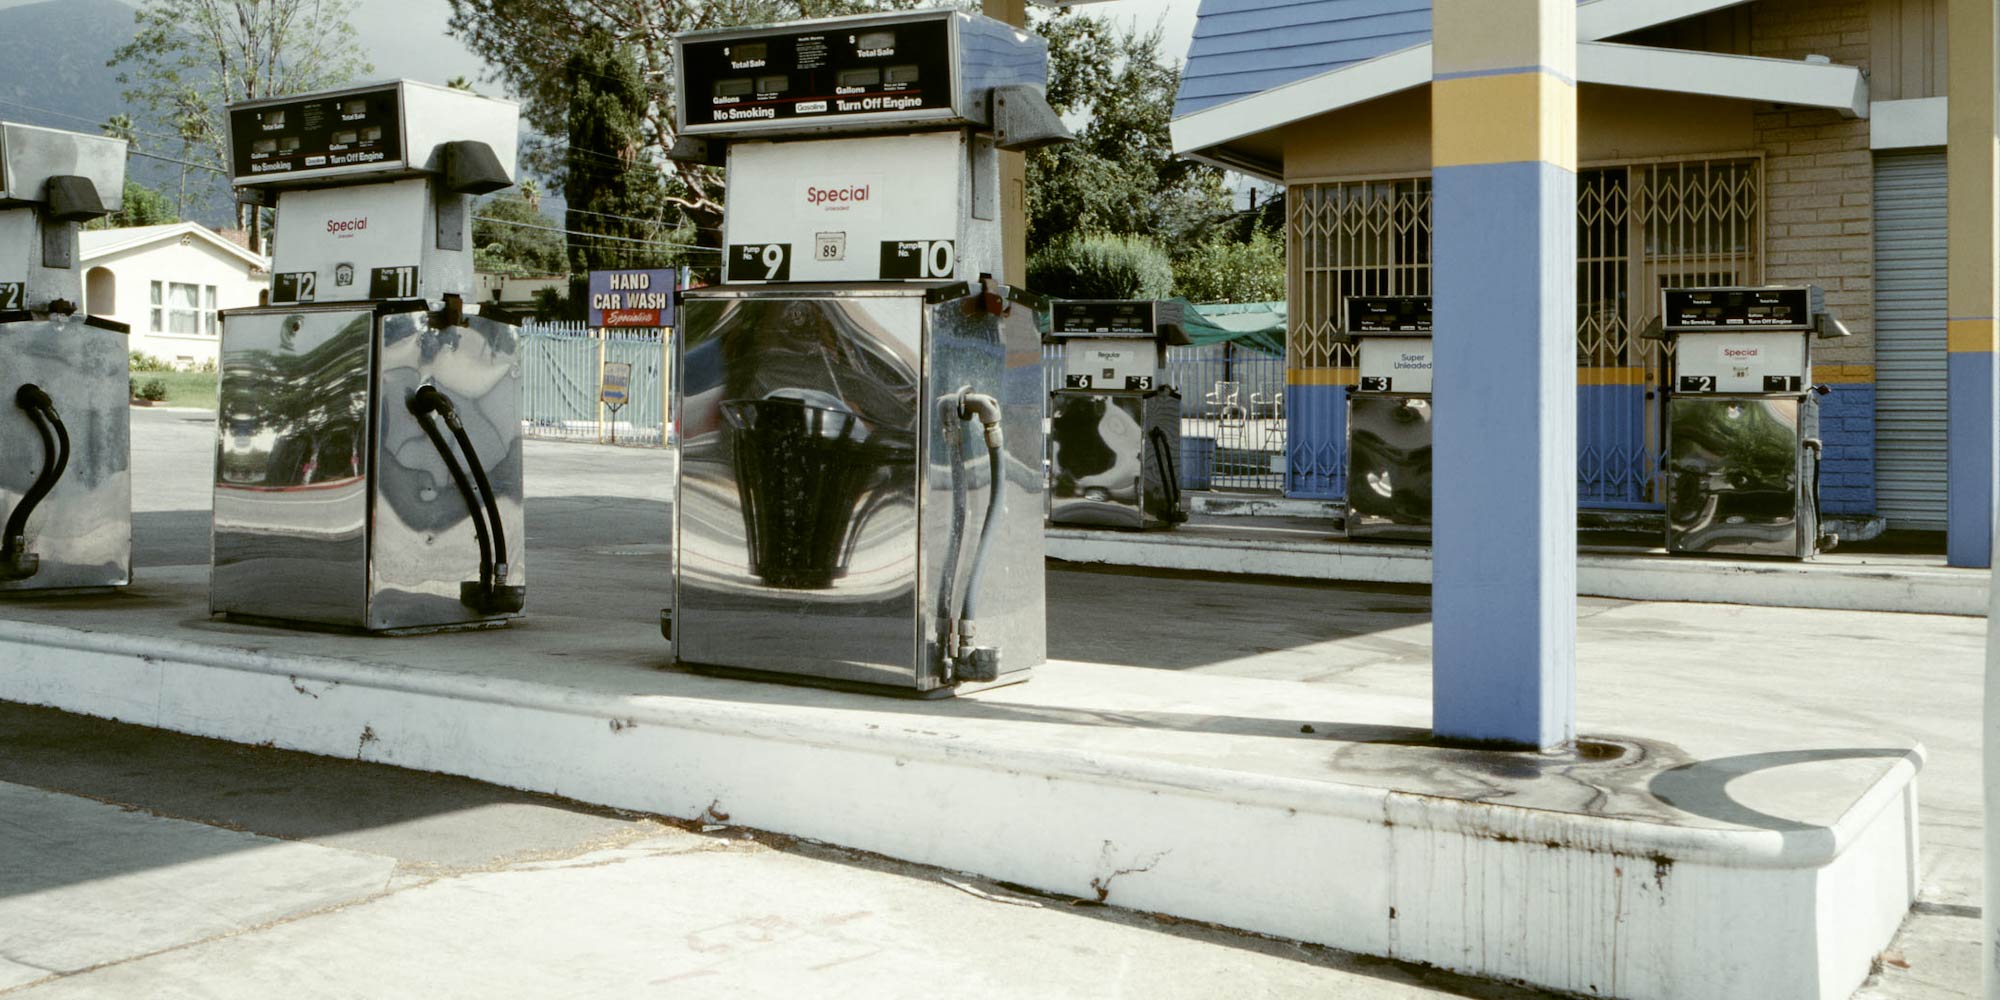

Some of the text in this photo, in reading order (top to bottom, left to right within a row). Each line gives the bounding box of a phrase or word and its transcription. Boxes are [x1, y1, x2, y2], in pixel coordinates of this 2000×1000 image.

[857, 47, 894, 58] Total Sale
[731, 59, 766, 70] Total Sale
[835, 85, 865, 94] Gallons
[713, 95, 740, 105] Gallons
[836, 95, 922, 111] Turn Off Engine
[713, 106, 775, 121] No Smoking
[797, 102, 826, 112] Gasoline
[330, 151, 384, 164] Turn Off Engine
[252, 161, 292, 172] No Smoking
[807, 184, 869, 206] Special
[327, 217, 367, 234] Special
[743, 246, 760, 254] Pump
[823, 245, 837, 257] 89
[898, 242, 918, 250] Pump
[762, 244, 784, 280] 9
[917, 240, 954, 279] 10
[295, 272, 315, 300] 12
[396, 267, 413, 297] 11
[610, 273, 650, 290] HAND
[593, 293, 666, 310] CAR WASH
[1098, 351, 1120, 359] Regular
[1401, 354, 1424, 362] Super
[1724, 348, 1757, 358] Special
[1079, 375, 1088, 388] 6
[1139, 376, 1149, 390] 5
[1377, 377, 1387, 391] 3
[1699, 377, 1711, 391] 2
[1784, 377, 1791, 391] 1
